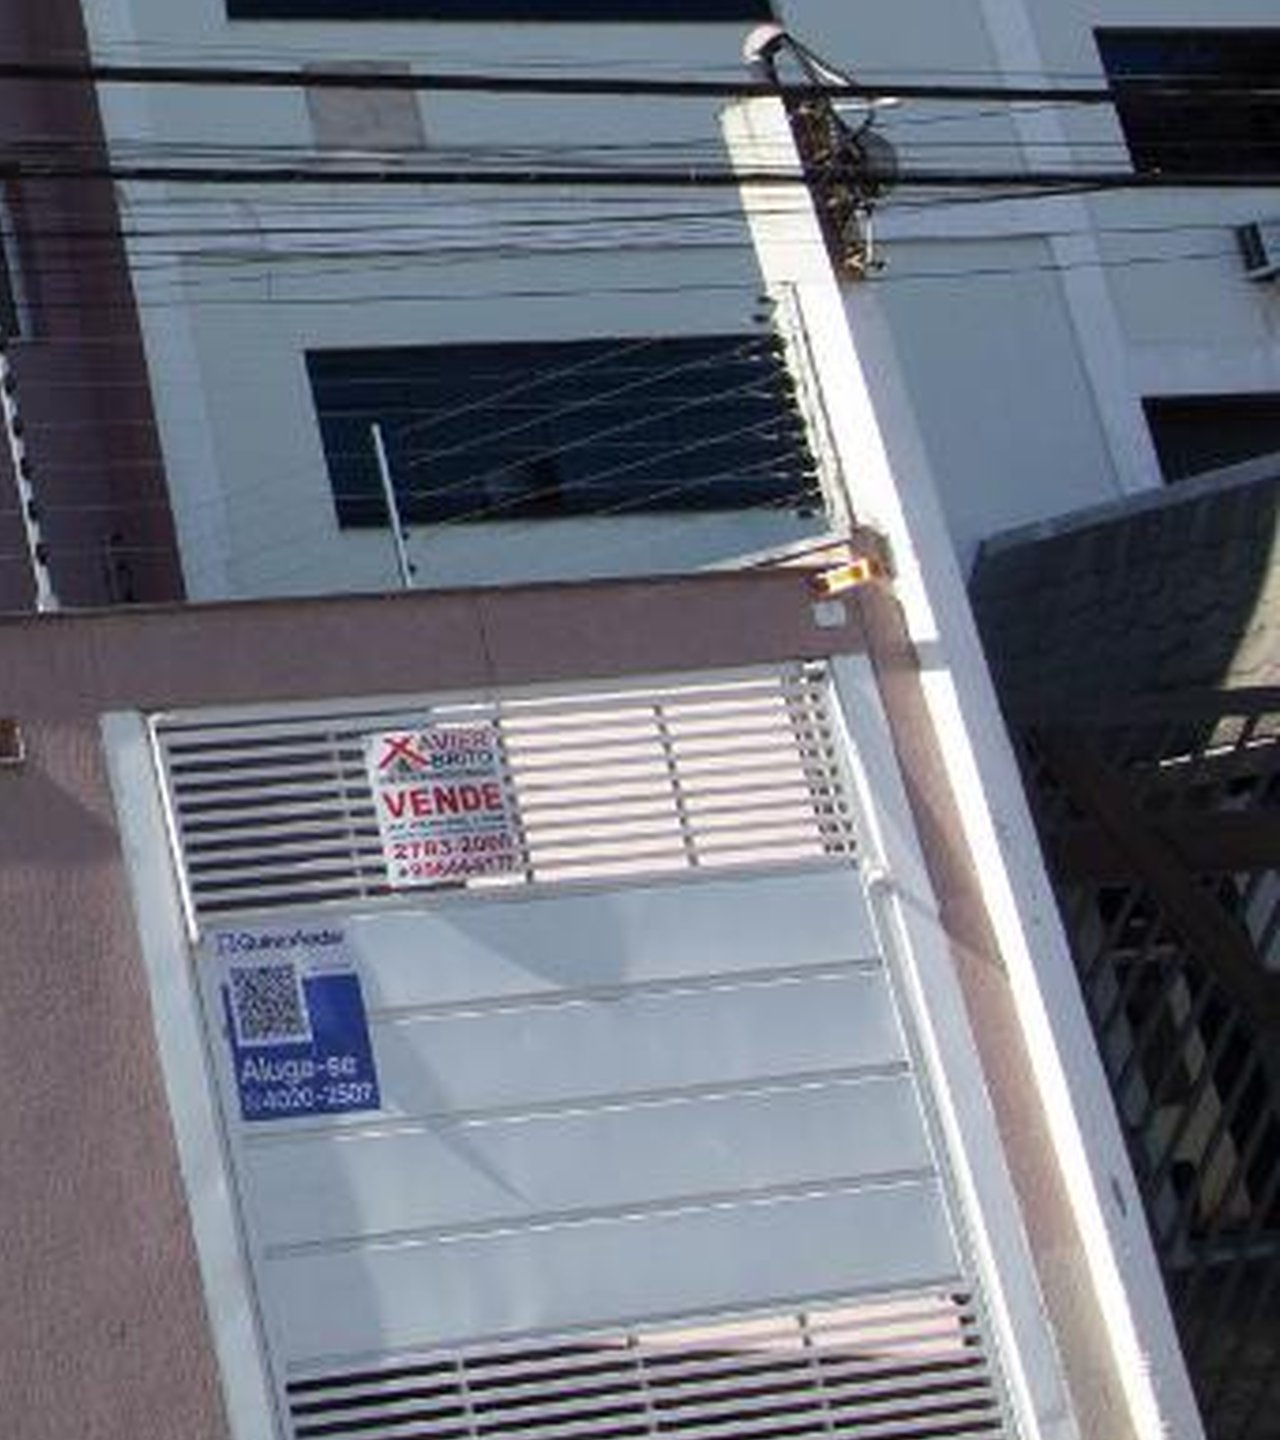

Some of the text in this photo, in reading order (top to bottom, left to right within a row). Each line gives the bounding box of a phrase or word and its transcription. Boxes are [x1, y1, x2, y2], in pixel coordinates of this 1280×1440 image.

[378, 731, 489, 769] XAVIER
[382, 783, 504, 819] VENDE
[241, 1056, 358, 1085] Aluga-se
